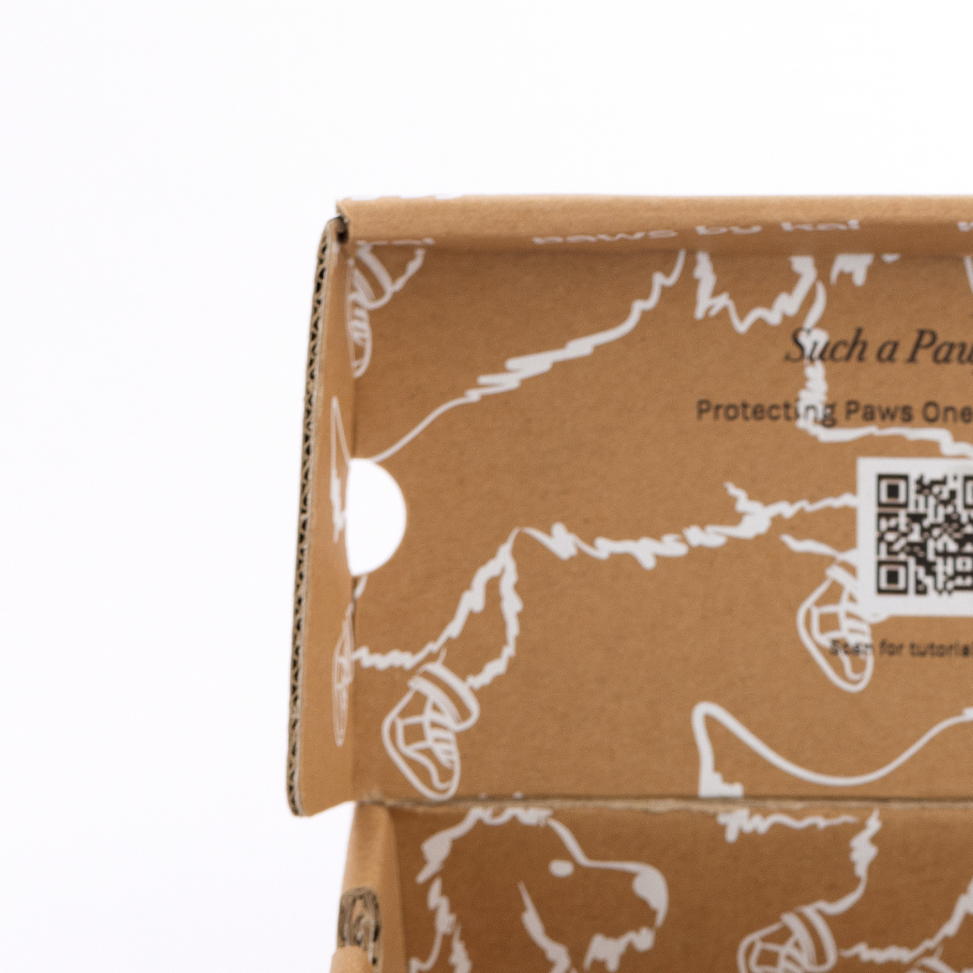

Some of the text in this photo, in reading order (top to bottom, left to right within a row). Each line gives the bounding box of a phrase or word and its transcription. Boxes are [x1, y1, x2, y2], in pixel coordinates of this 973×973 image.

[783, 326, 868, 364] Such
[876, 337, 900, 363] a
[845, 400, 914, 424] Paws
[922, 400, 973, 425] One
[880, 639, 904, 658] for
